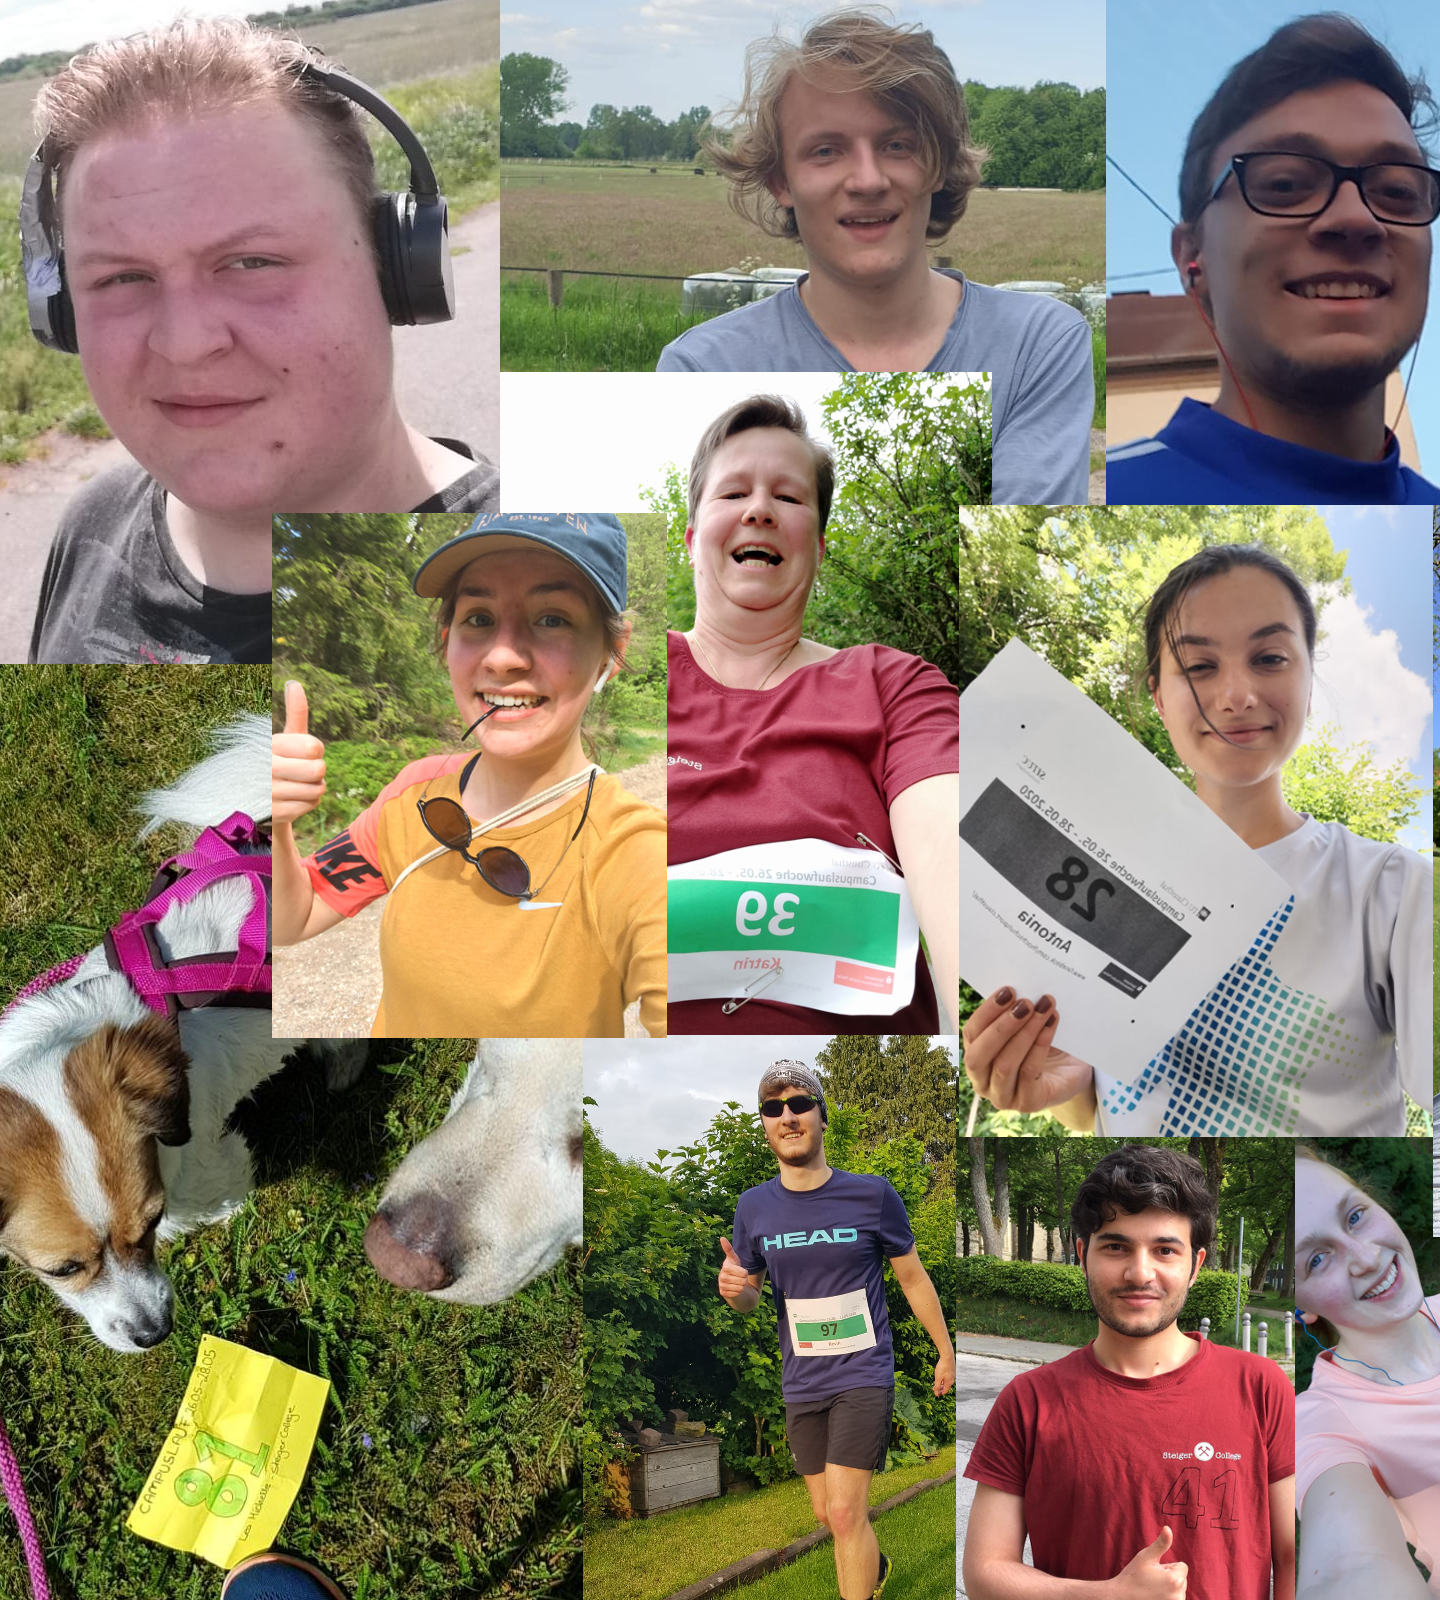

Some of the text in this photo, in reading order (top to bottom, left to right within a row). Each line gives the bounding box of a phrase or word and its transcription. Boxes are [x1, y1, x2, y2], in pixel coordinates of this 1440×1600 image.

[764, 1228, 858, 1252] HEAD
[820, 1322, 838, 1336] 97
[1162, 1452, 1242, 1460] Steiger College
[174, 1430, 270, 1518] 81
[1162, 1466, 1240, 1530] 41
